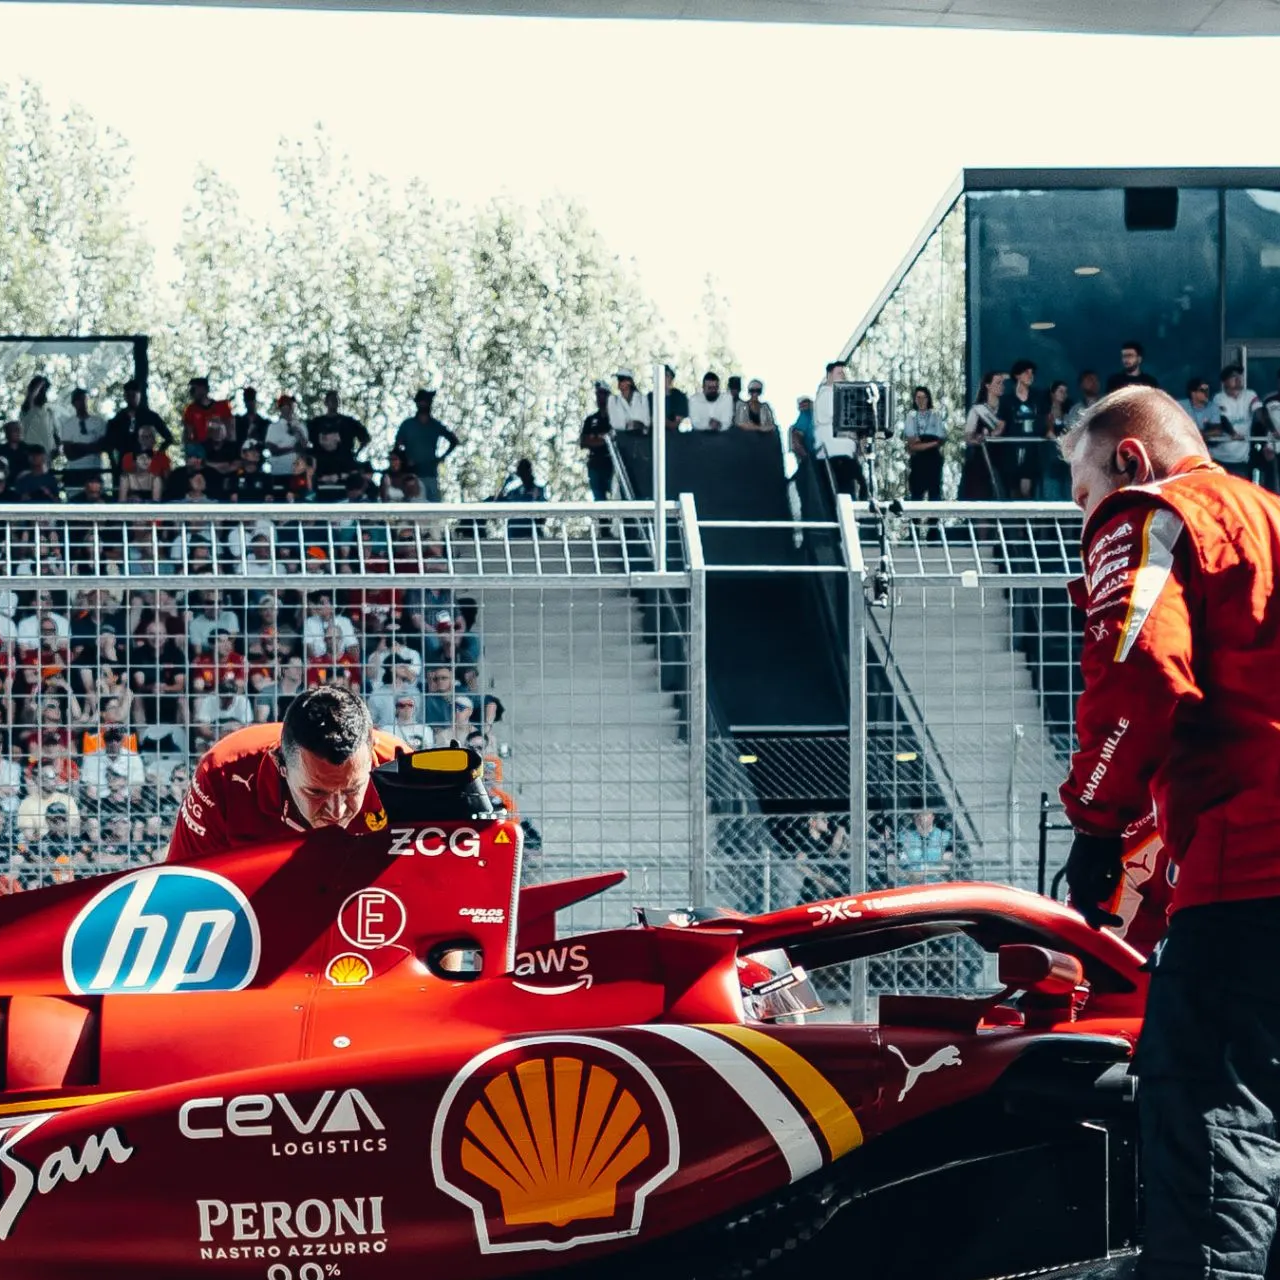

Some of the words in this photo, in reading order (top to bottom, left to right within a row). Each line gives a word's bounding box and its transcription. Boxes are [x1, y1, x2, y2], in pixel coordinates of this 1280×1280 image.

[1099, 716, 1130, 763] MILLE
[387, 826, 480, 858] ZCG
[459, 907, 504, 916] CARLOS
[471, 914, 506, 924] SAINZ
[88, 874, 236, 992] hp
[514, 944, 589, 977] aws
[272, 1138, 387, 1156] LOGISTICS
[196, 1196, 385, 1242] PERONI
[200, 1246, 280, 1260] NASTRO
[287, 1240, 388, 1257] AZZURRO
